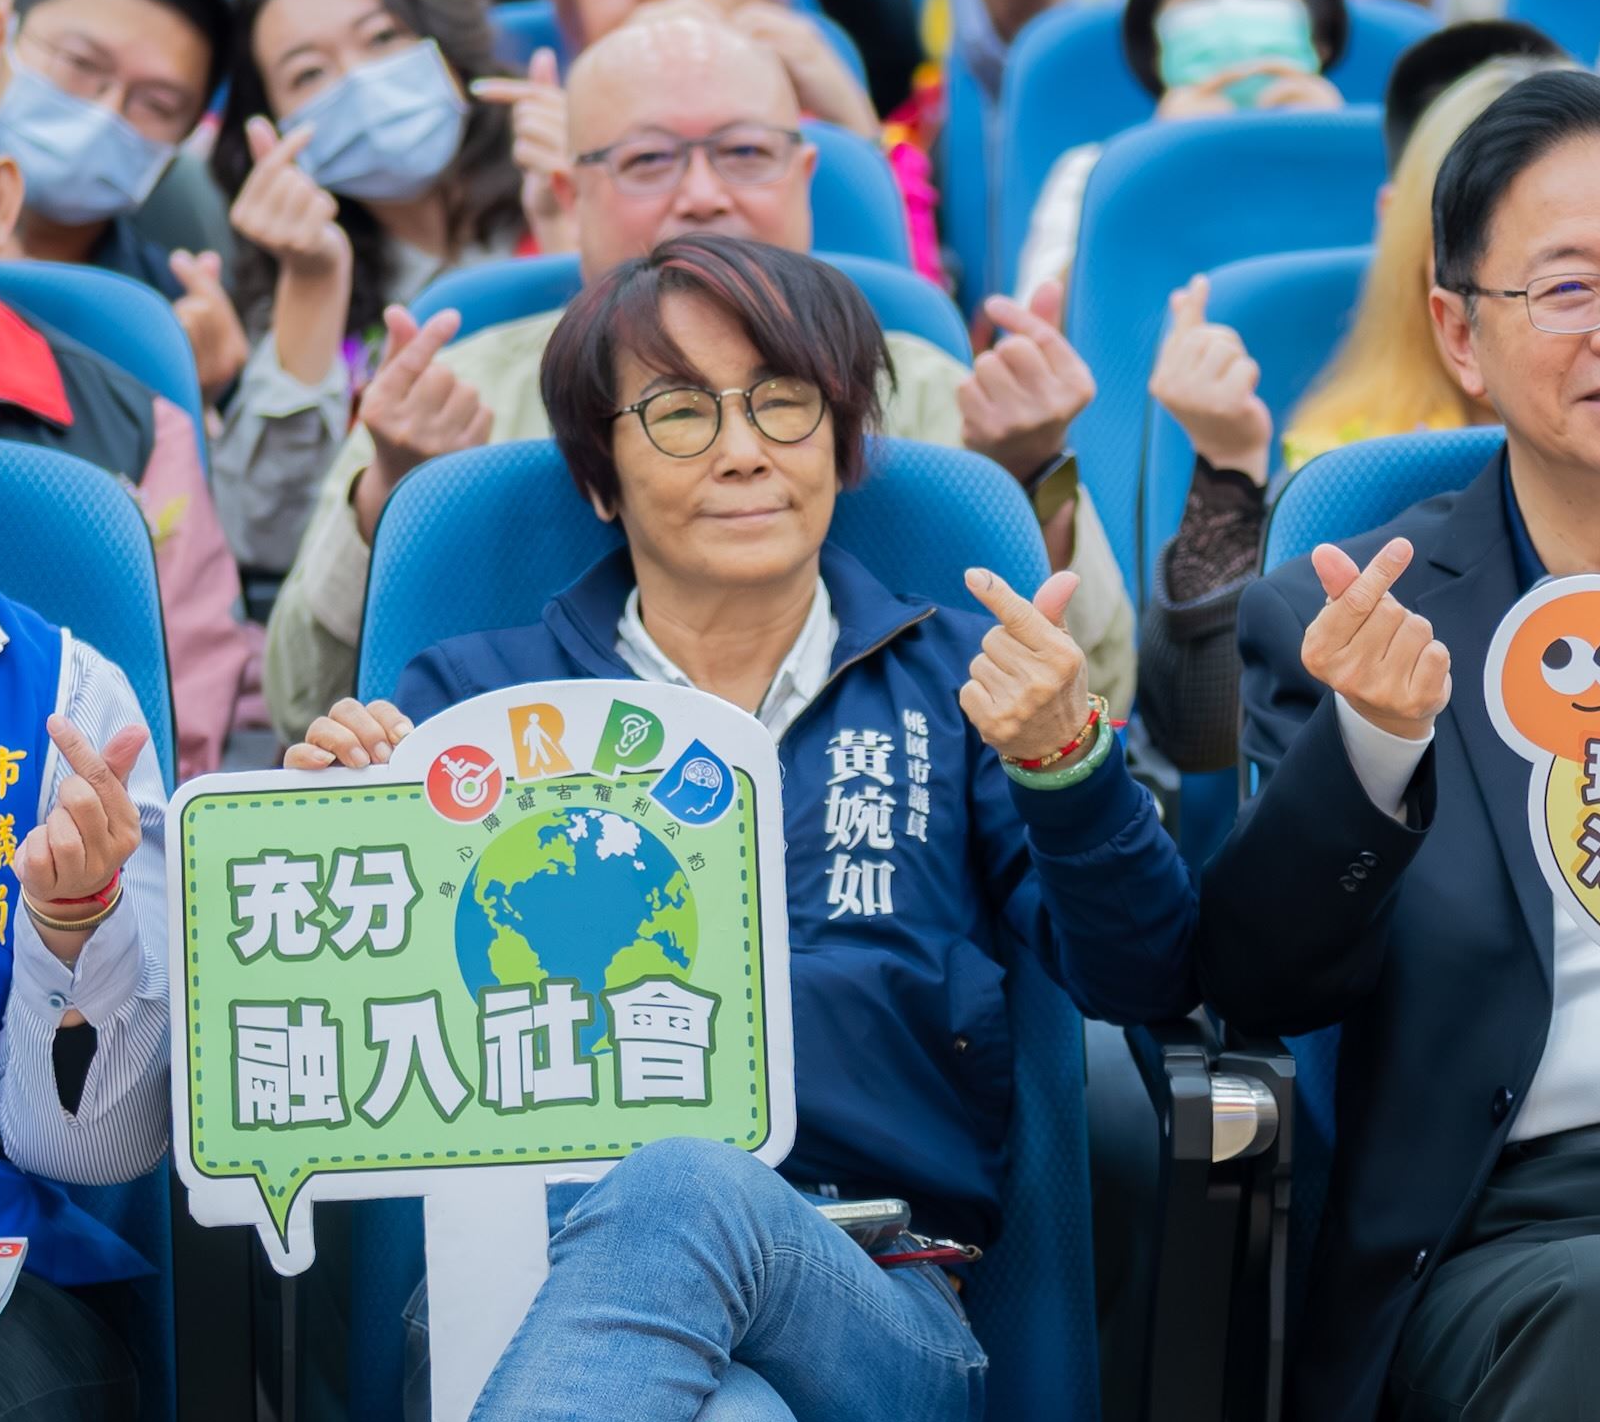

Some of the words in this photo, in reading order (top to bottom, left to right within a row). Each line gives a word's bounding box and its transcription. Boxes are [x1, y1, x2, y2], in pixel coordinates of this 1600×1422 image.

[426, 698, 735, 824] CRPD
[439, 783, 706, 898] 身心障礙者權利公約
[230, 848, 421, 960] 充分
[229, 976, 720, 1130] 融入社會
